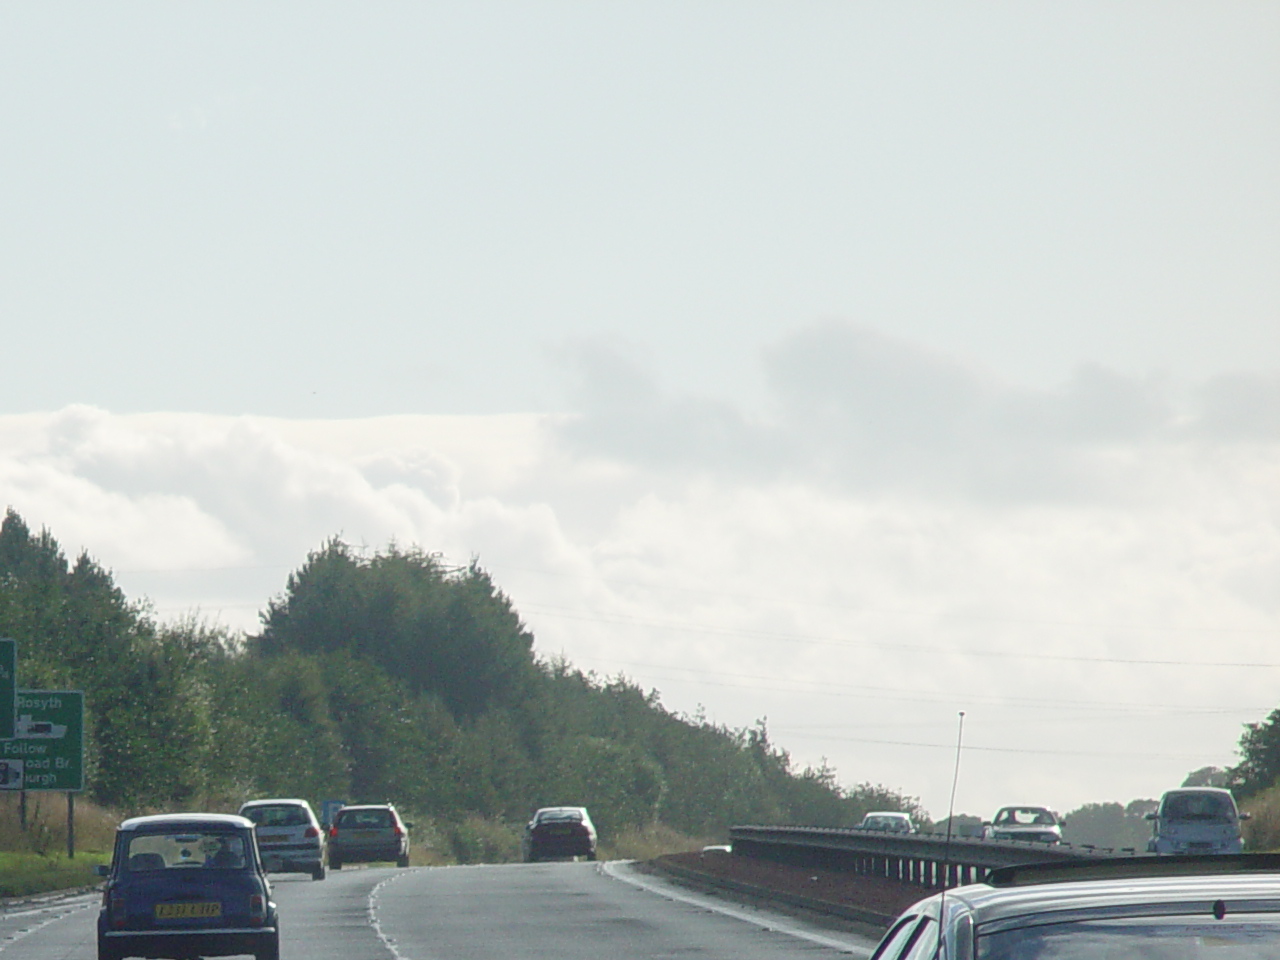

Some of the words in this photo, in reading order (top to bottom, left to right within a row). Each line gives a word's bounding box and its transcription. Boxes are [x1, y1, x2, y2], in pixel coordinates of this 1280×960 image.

[17, 696, 62, 711] Rosyth
[3, 742, 48, 755] Follow
[25, 757, 50, 770] oad
[55, 757, 73, 770] Br.
